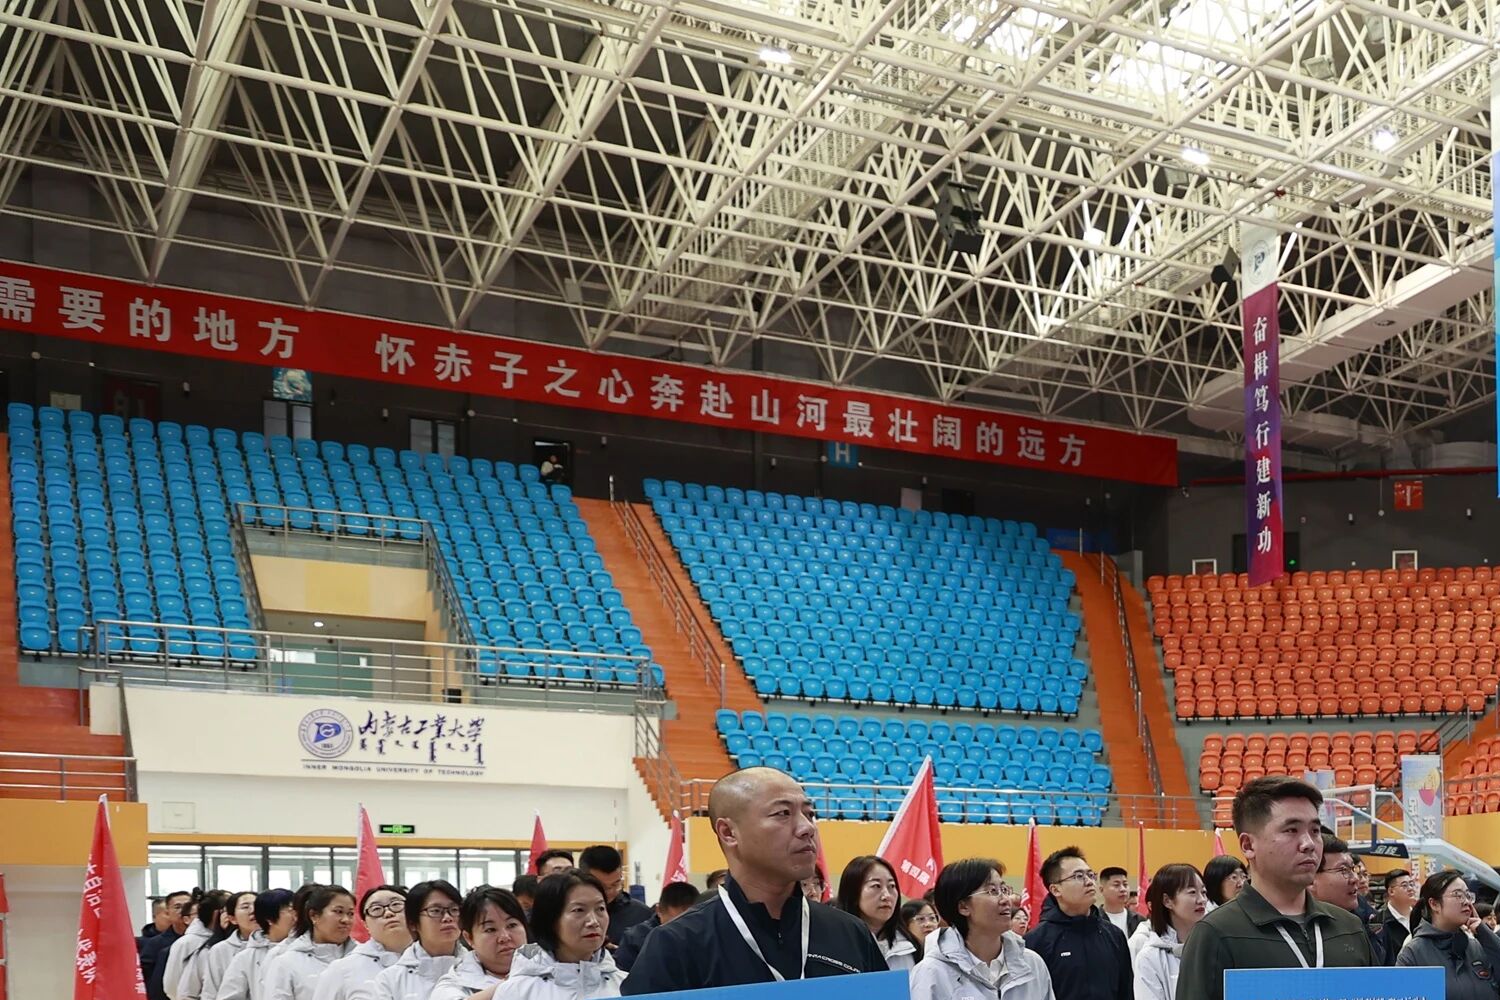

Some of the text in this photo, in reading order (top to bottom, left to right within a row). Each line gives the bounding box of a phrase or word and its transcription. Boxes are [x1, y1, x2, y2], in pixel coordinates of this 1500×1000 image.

[0, 276, 1087, 468] 需要的地方 怀赤子之心奔赴山河最壮阔的远方
[835, 441, 850, 464] H
[1253, 317, 1272, 554] 奋楫笃行建新功
[303, 763, 327, 771] INNER
[332, 764, 372, 772] MONGOLIA
[438, 769, 485, 777] TECHNOLOGY
